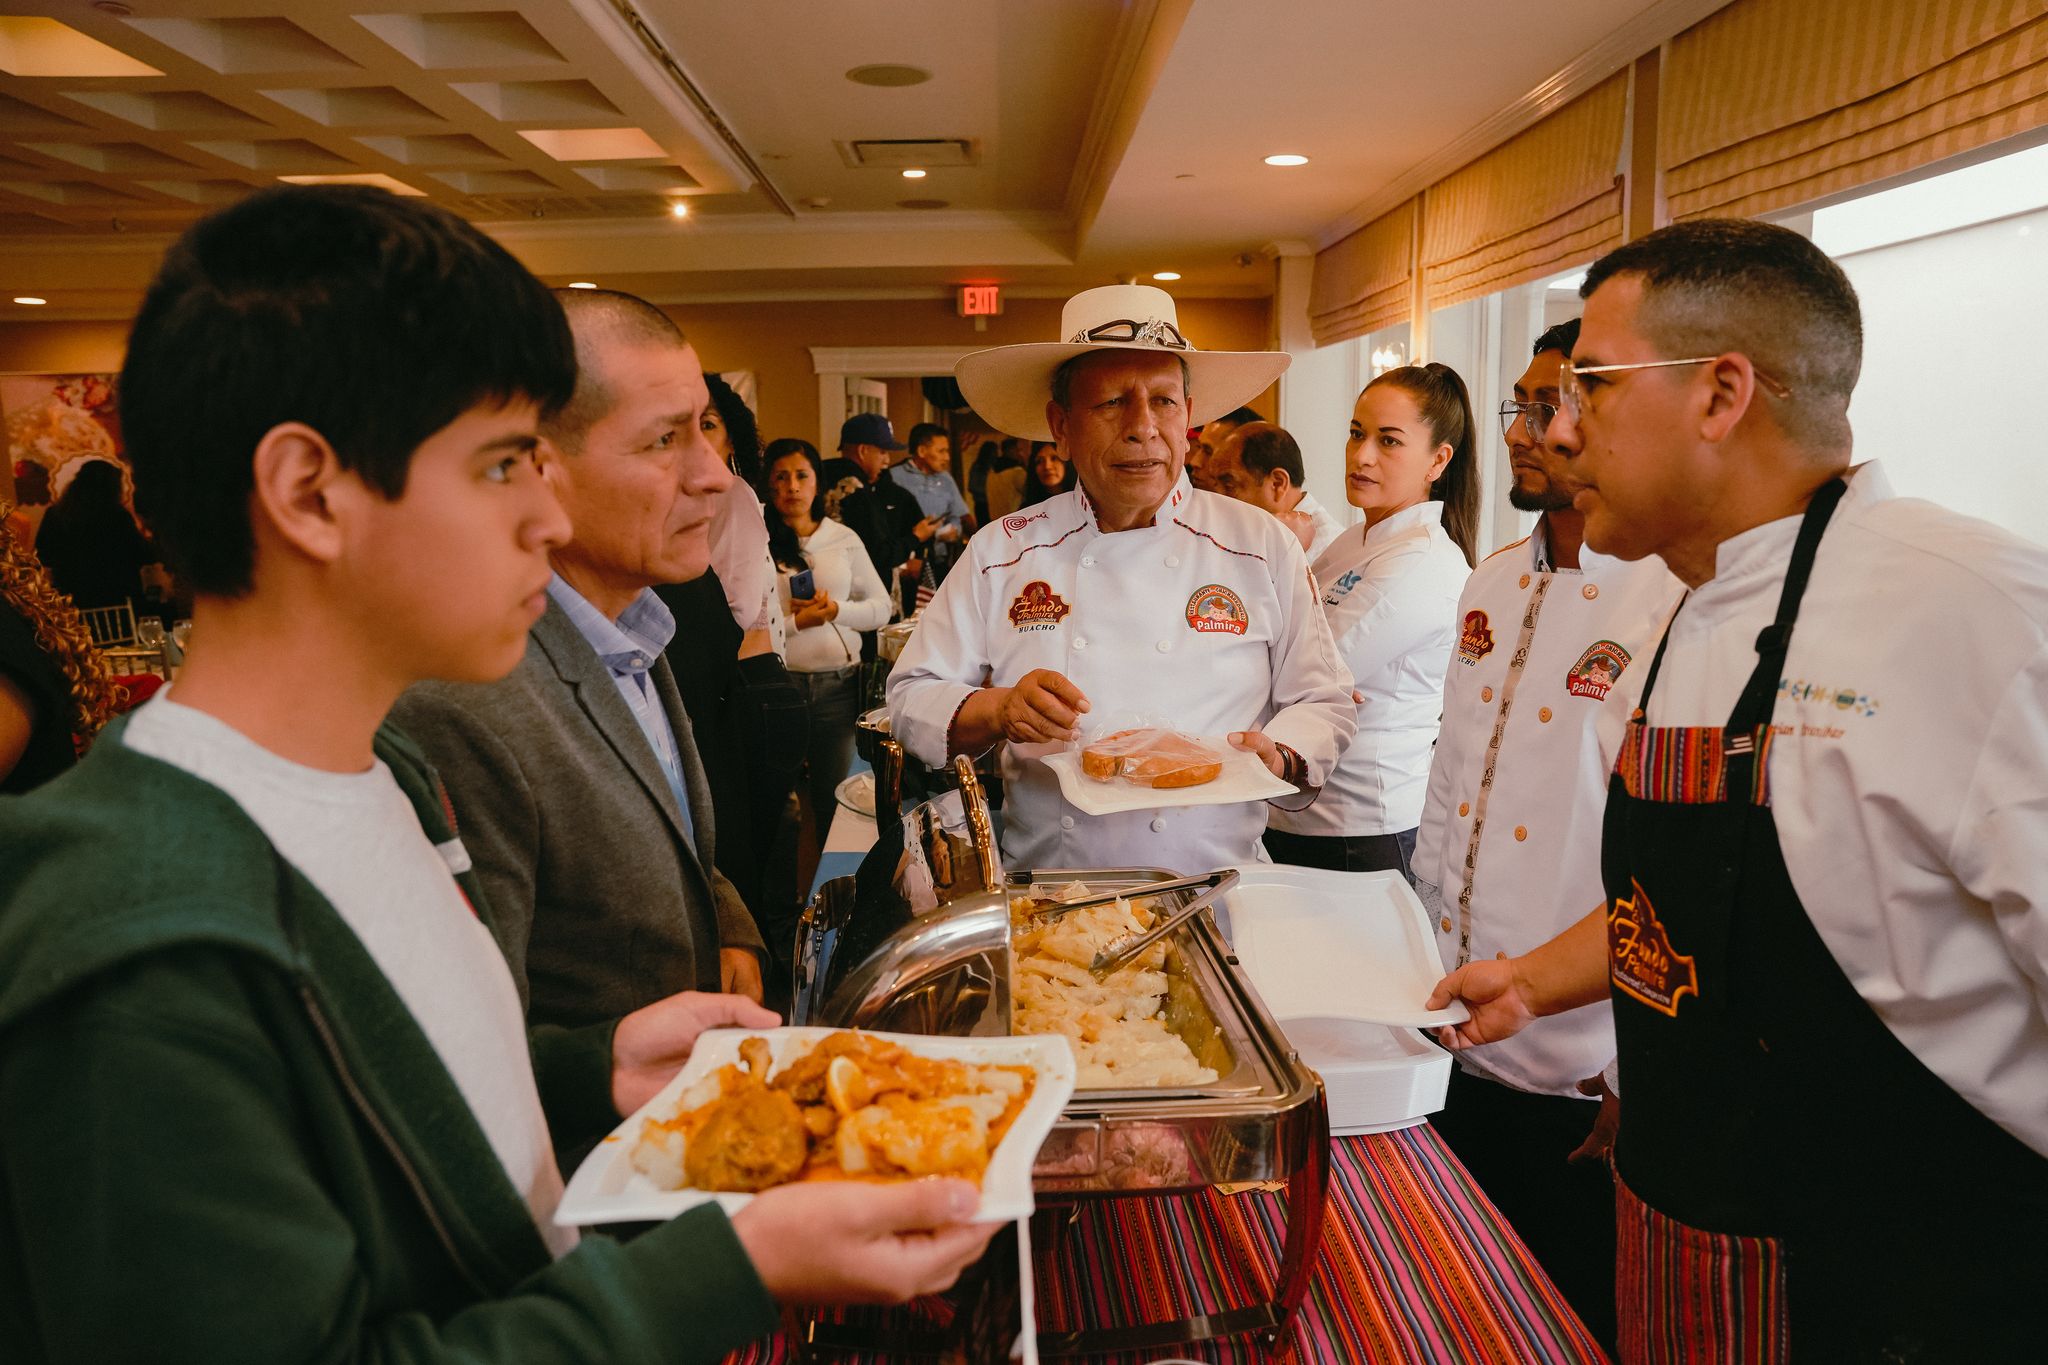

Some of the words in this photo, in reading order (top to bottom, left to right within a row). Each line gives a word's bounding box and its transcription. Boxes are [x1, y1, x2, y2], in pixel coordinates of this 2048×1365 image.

[964, 287, 999, 314] EXIT
[1015, 600, 1063, 619] Fundo
[1019, 624, 1056, 633] HUACHO
[1197, 620, 1241, 634] Palmira
[1462, 634, 1489, 649] undo
[1572, 682, 1607, 698] Palmi
[1615, 918, 1669, 973] Fundo
[1625, 953, 1665, 990] Palmira
